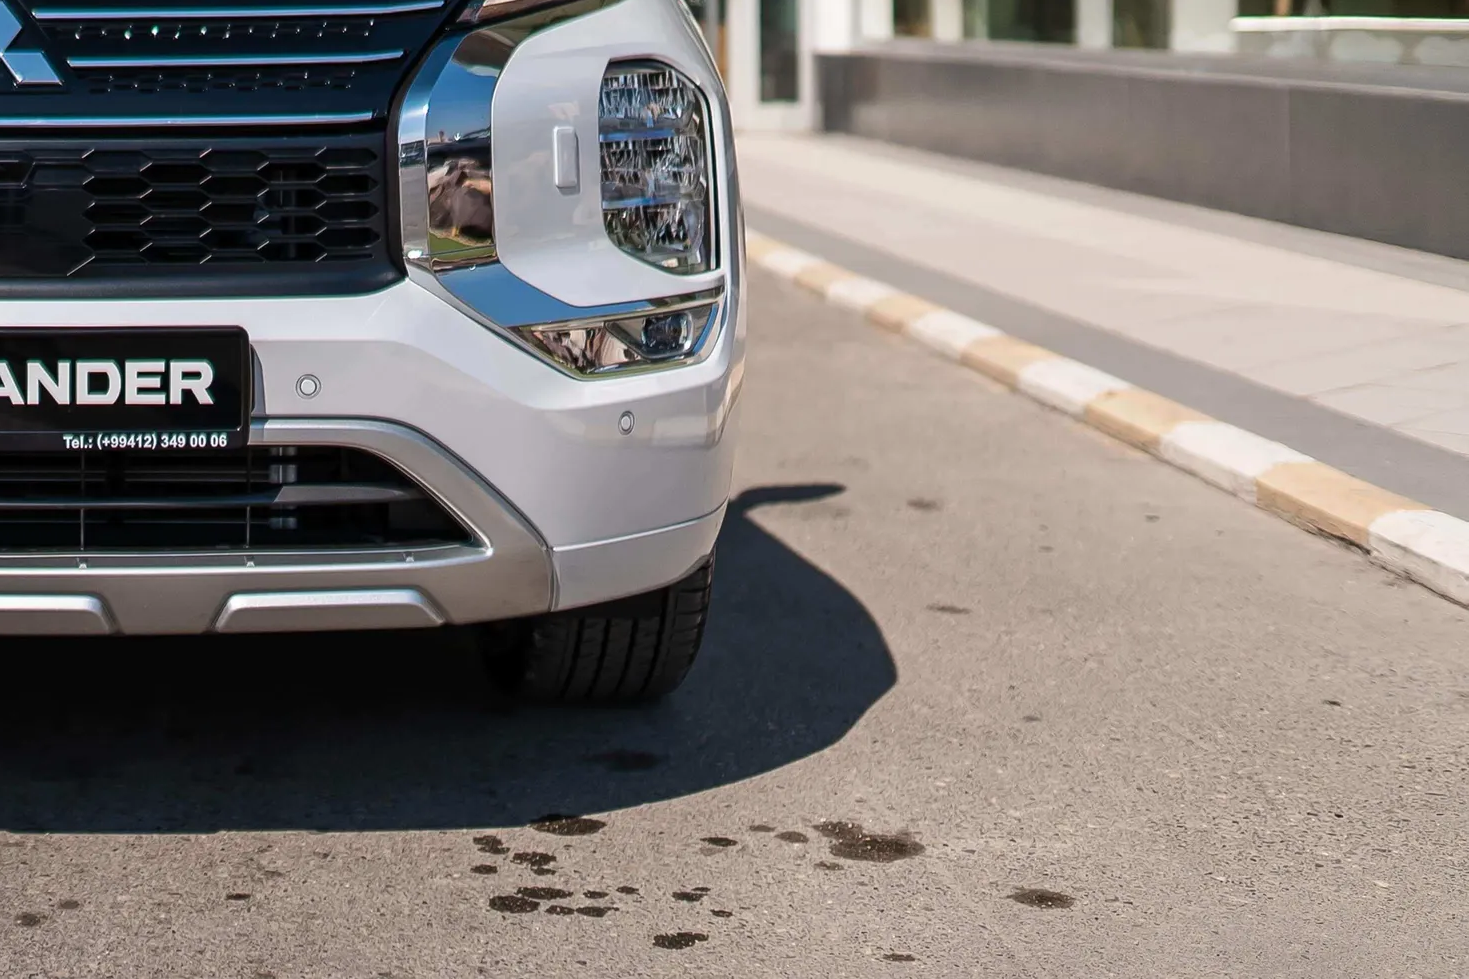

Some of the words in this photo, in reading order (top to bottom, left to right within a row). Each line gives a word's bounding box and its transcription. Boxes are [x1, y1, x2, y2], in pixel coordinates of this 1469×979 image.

[62, 433, 93, 449] Tel.:
[96, 432, 158, 450] (+99412)
[160, 432, 187, 448] 349
[189, 432, 207, 448] 00
[209, 432, 228, 448] 06
